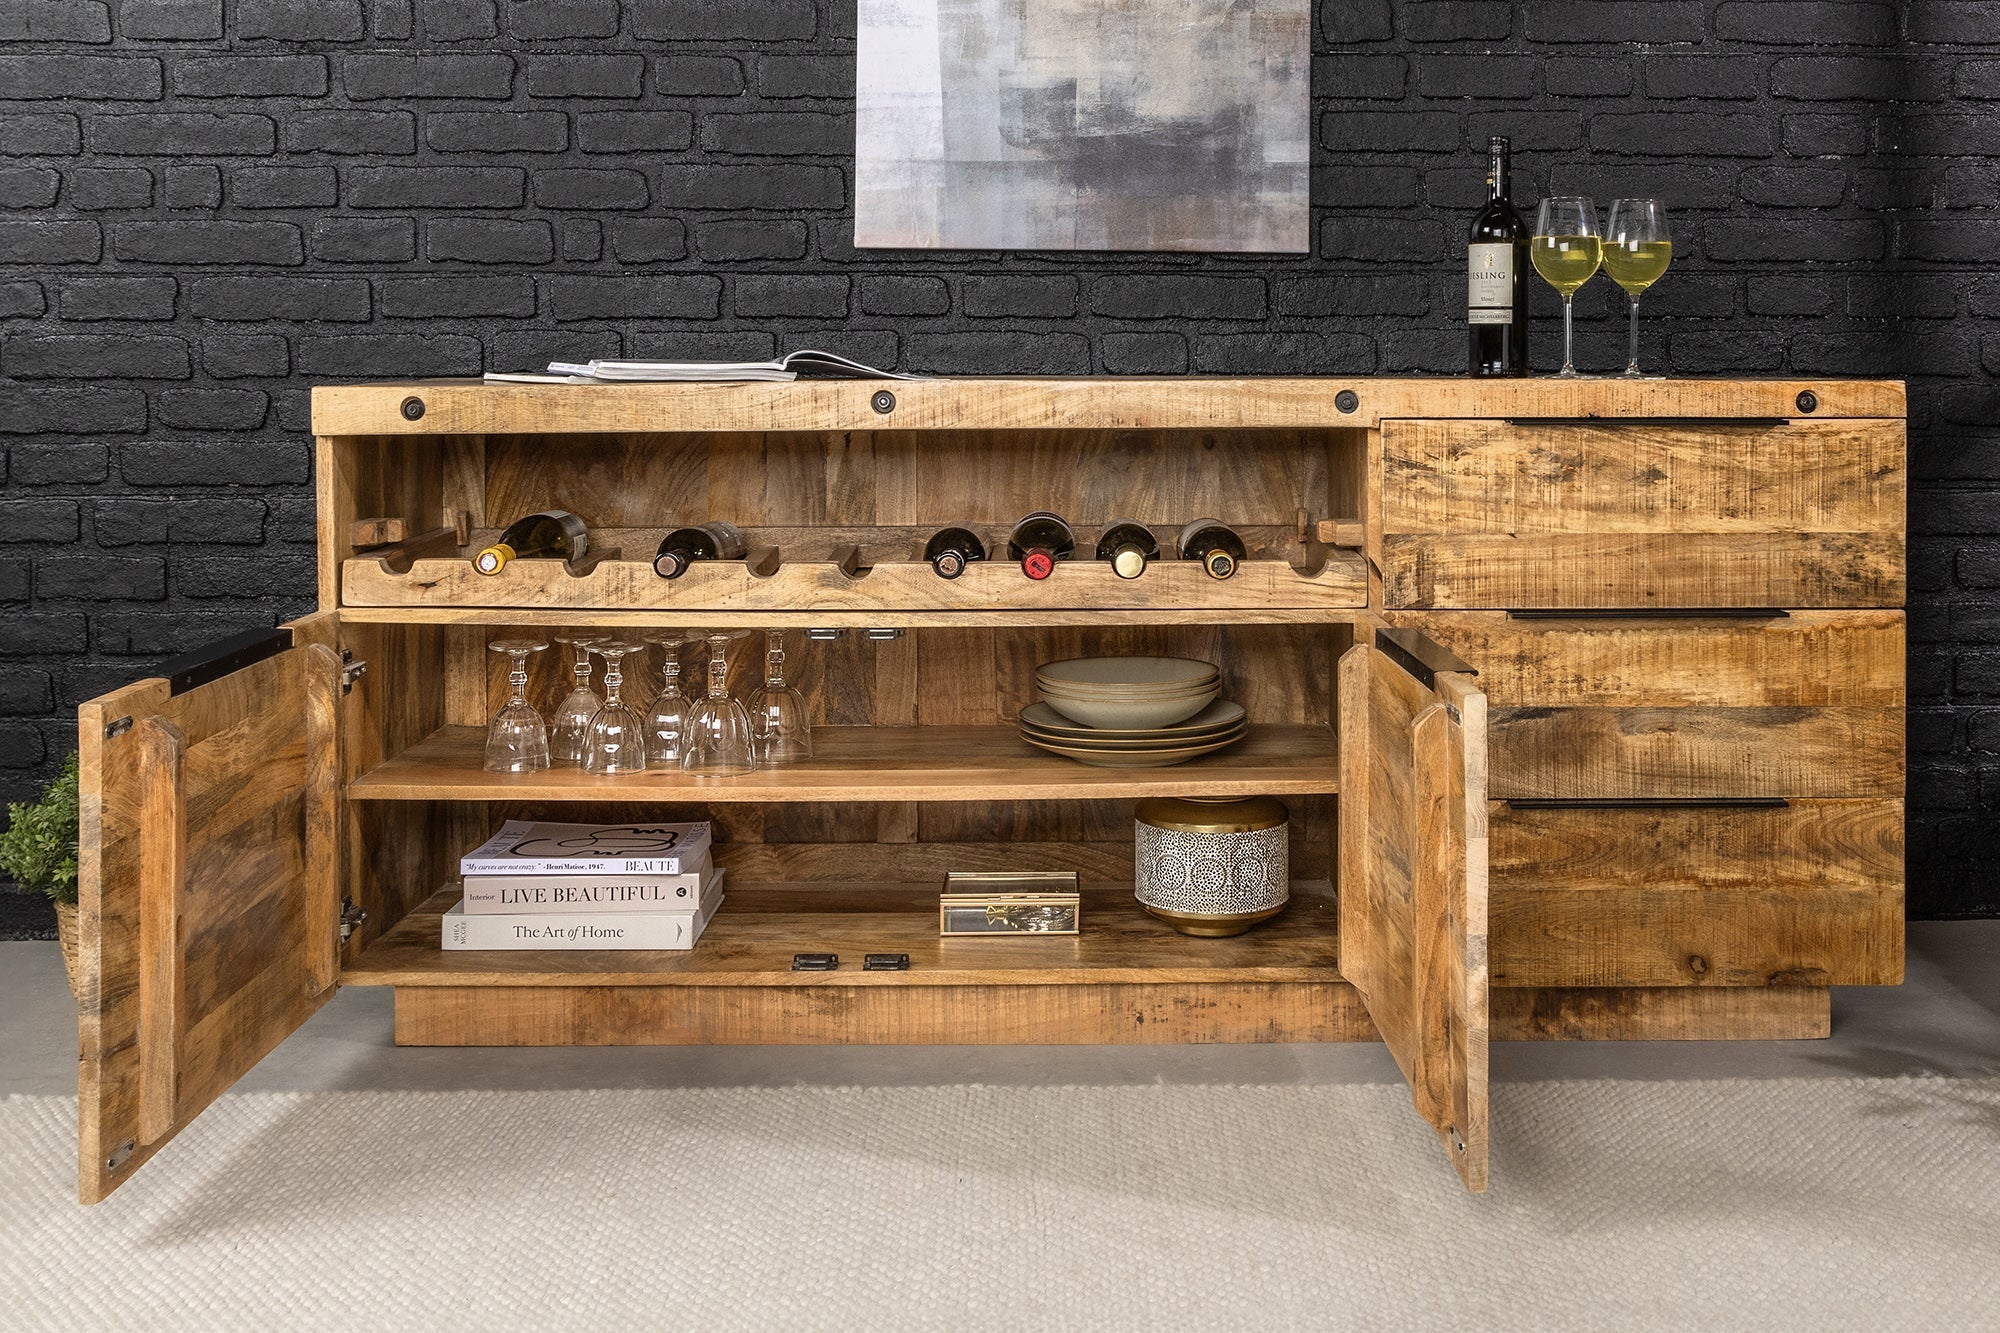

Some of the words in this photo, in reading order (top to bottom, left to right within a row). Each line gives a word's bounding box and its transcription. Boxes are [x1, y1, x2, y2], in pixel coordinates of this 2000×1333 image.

[469, 893, 496, 901] Interior
[500, 887, 547, 904] LIVE
[553, 885, 666, 903] BEAUTIFUL
[513, 925, 540, 938] The
[543, 925, 564, 938] Art
[567, 925, 582, 942] of
[582, 925, 624, 938] Home
